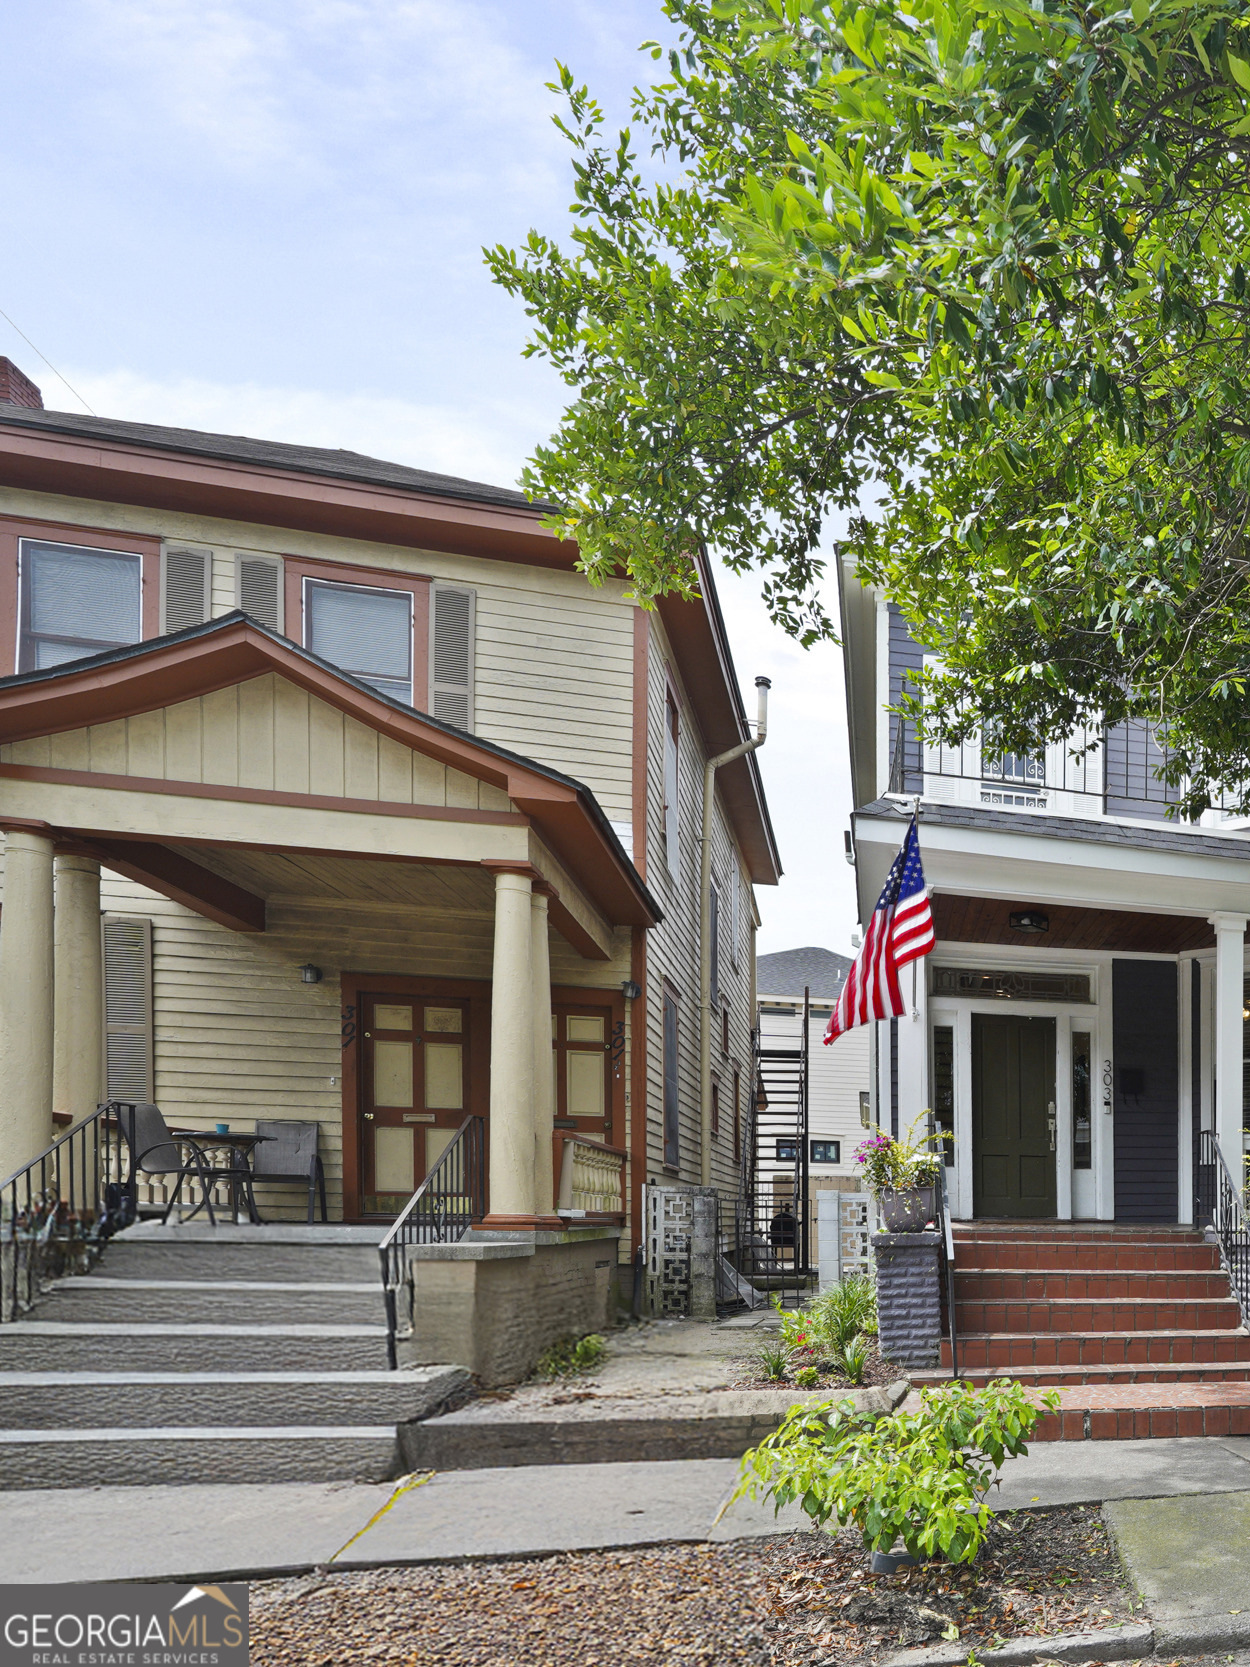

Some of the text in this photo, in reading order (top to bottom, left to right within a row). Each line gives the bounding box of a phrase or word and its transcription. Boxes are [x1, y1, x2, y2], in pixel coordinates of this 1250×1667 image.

[341, 1004, 356, 1048] 301
[612, 1021, 625, 1060] 301
[1103, 1059, 1112, 1100] 303
